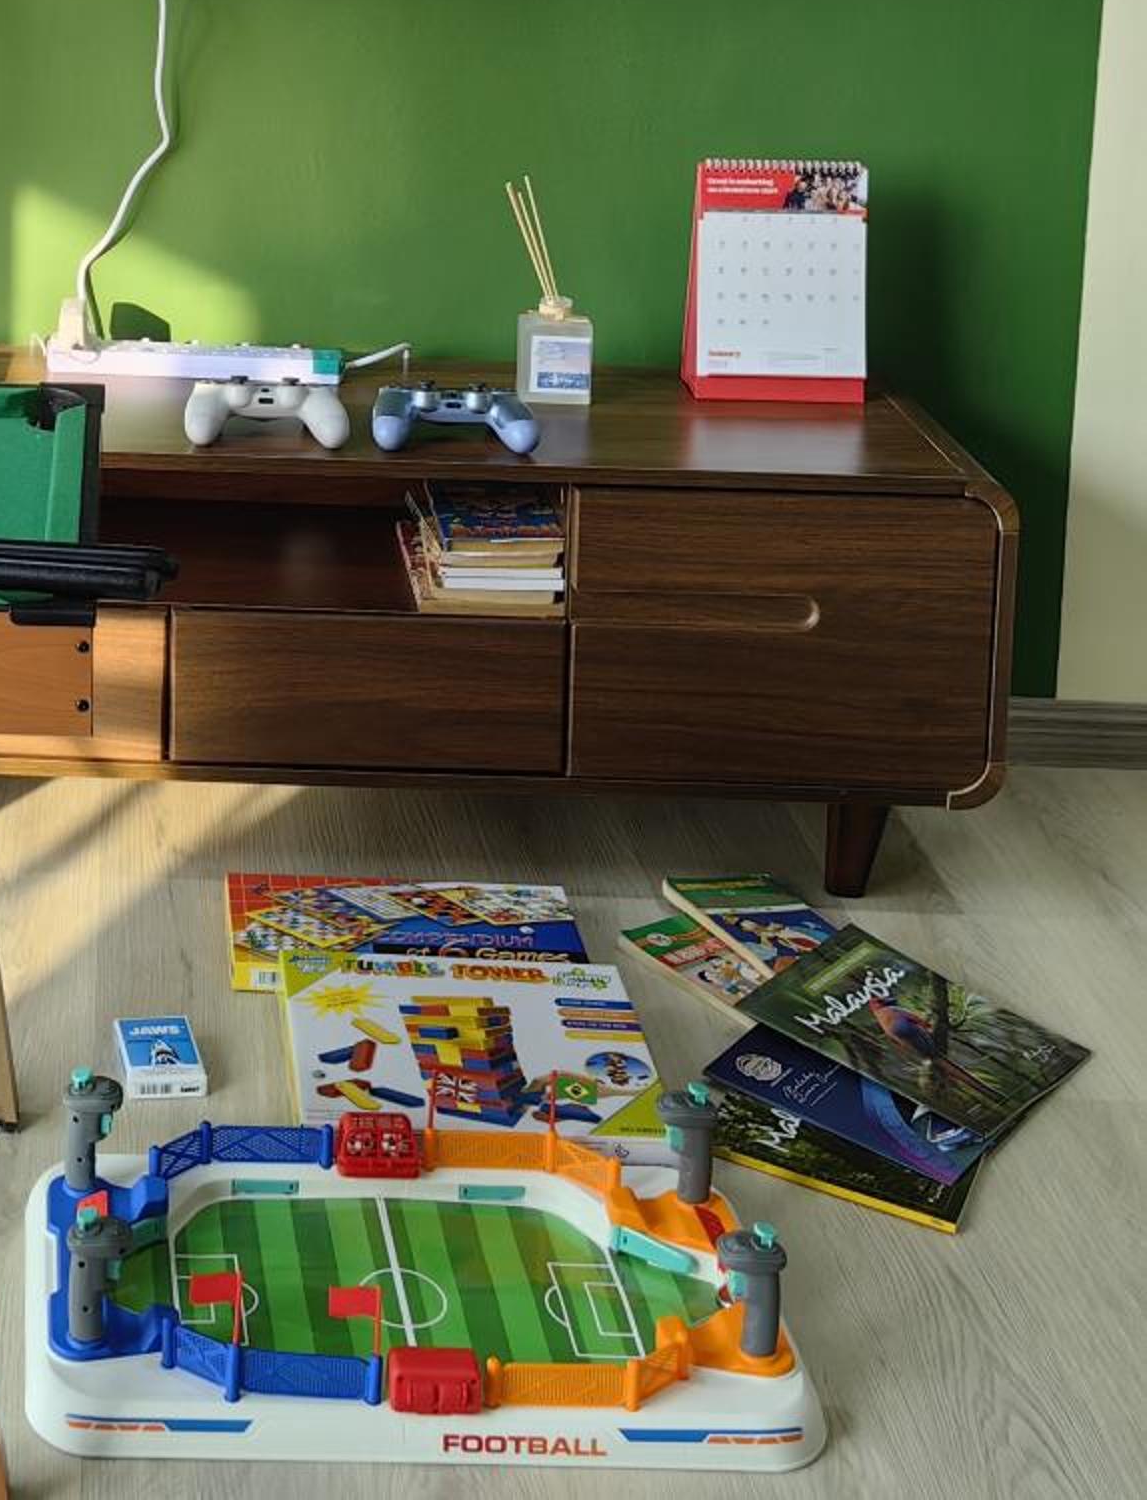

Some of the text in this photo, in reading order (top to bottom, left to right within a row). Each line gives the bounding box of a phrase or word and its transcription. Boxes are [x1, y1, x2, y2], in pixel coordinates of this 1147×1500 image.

[451, 962, 551, 985] TOWER
[793, 965, 906, 1035] Malaysia
[128, 1025, 181, 1037] JAWS
[442, 1434, 608, 1457] FOOTBALL
